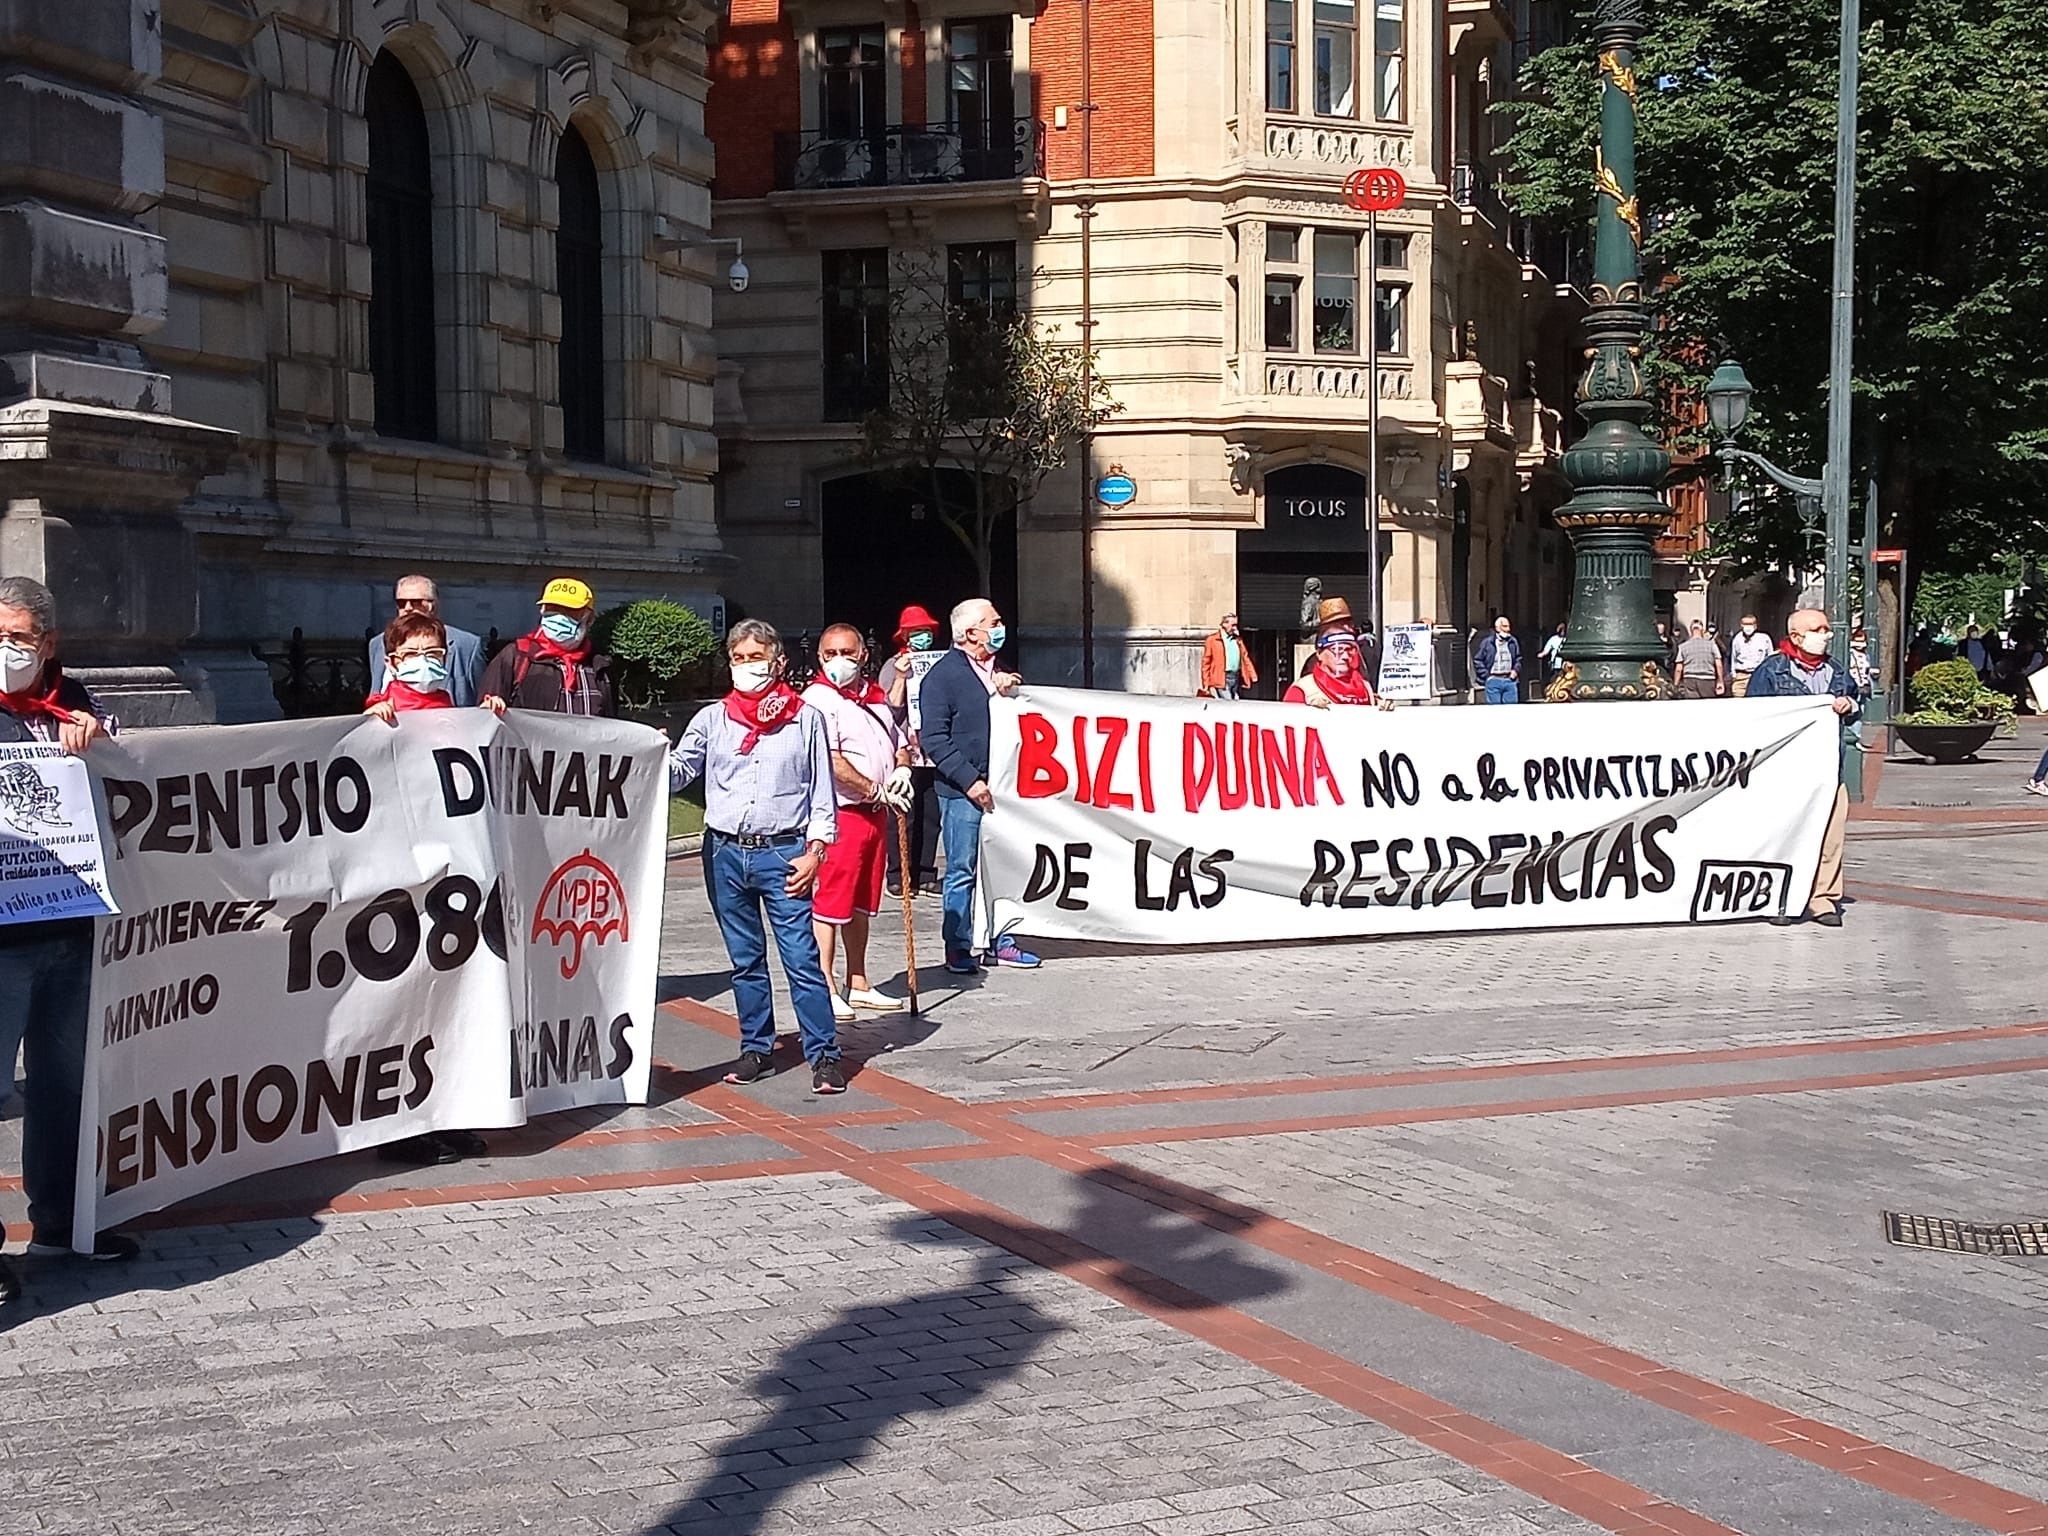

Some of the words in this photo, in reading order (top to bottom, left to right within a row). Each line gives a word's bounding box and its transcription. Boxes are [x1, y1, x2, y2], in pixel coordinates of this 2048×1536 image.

[1286, 500, 1347, 517] TOUS
[1017, 712, 1156, 813] BIZI
[1183, 722, 1345, 813] DUINA
[1361, 750, 1419, 809] NO
[1442, 772, 1473, 801] a
[1477, 752, 1519, 801] la
[102, 756, 372, 861] PENTSIO
[78, 833, 95, 843] ALDE
[5, 866, 38, 880] cuidado
[40, 867, 51, 877] no
[52, 865, 62, 875] es
[1022, 842, 1094, 911] DE
[1134, 839, 1235, 911] LAS
[1300, 814, 1679, 910] RESIDENCIAS
[5, 891, 44, 917] público
[46, 891, 59, 904] no
[61, 887, 73, 901] se
[557, 878, 611, 919] MPB
[1701, 869, 1774, 914] MPB
[102, 973, 220, 1050] MINIMO
[96, 1034, 434, 1198] ENSIONES
